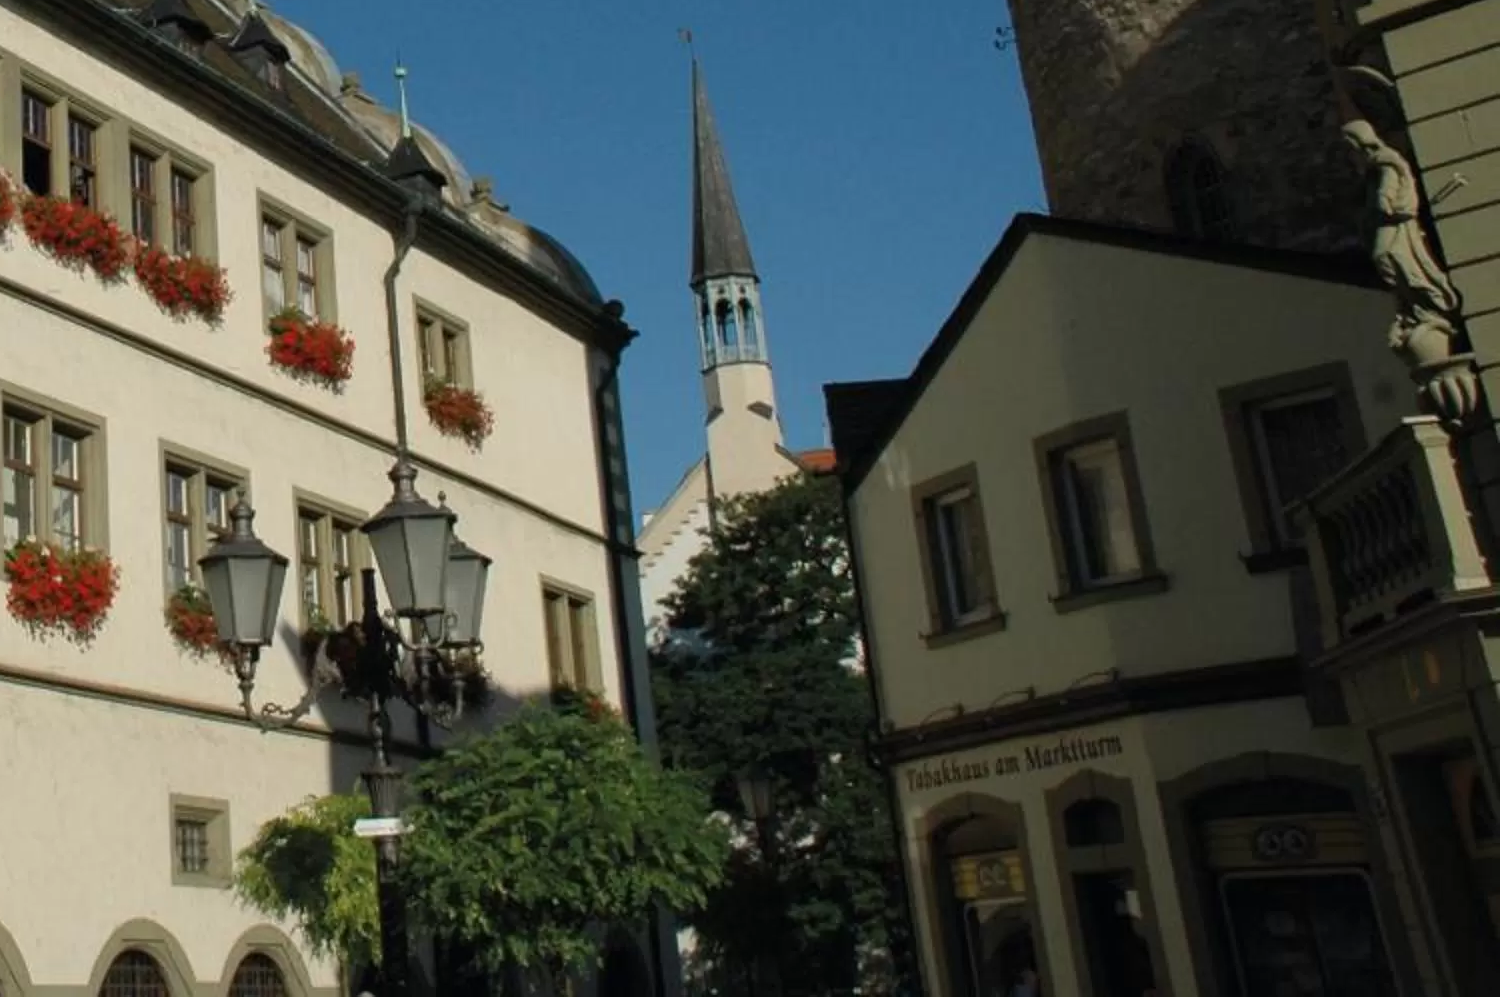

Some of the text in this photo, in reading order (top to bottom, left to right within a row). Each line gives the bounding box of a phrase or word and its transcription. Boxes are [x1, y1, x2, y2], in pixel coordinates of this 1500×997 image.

[906, 735, 1123, 792] Tabakhaus am Marktturm
